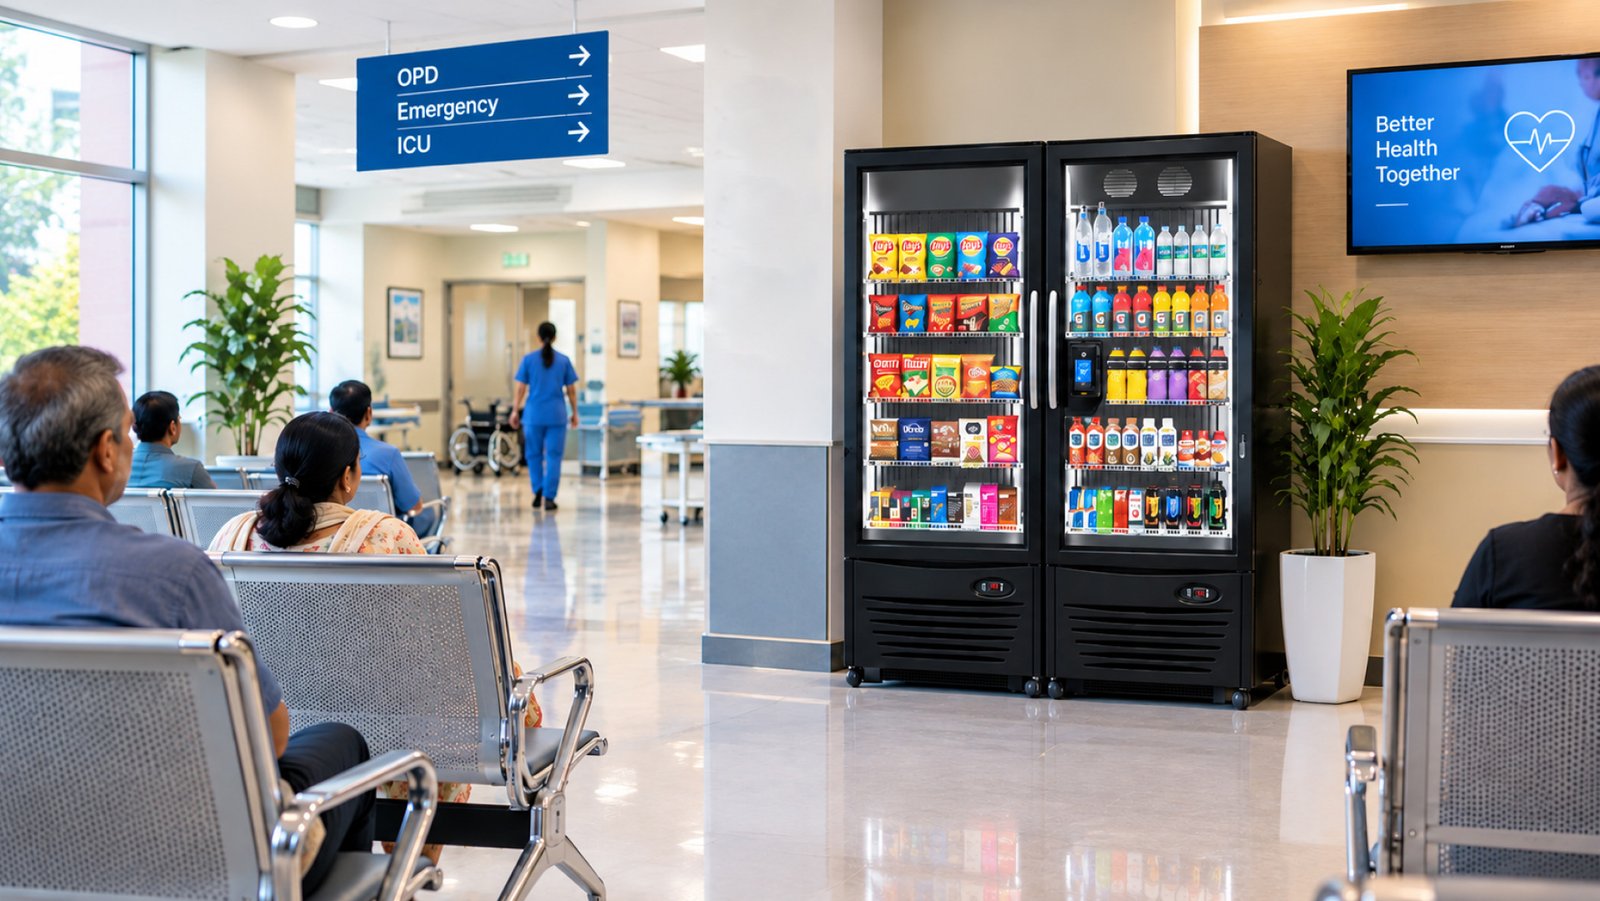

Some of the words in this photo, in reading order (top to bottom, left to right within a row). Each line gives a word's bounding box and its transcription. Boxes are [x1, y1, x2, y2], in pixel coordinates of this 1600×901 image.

[397, 66, 439, 87] OPD
[397, 98, 499, 121] Emergency
[1375, 115, 1435, 133] Better
[397, 134, 432, 155] ICU
[1375, 139, 1438, 158] Health
[1375, 164, 1461, 187] Together
